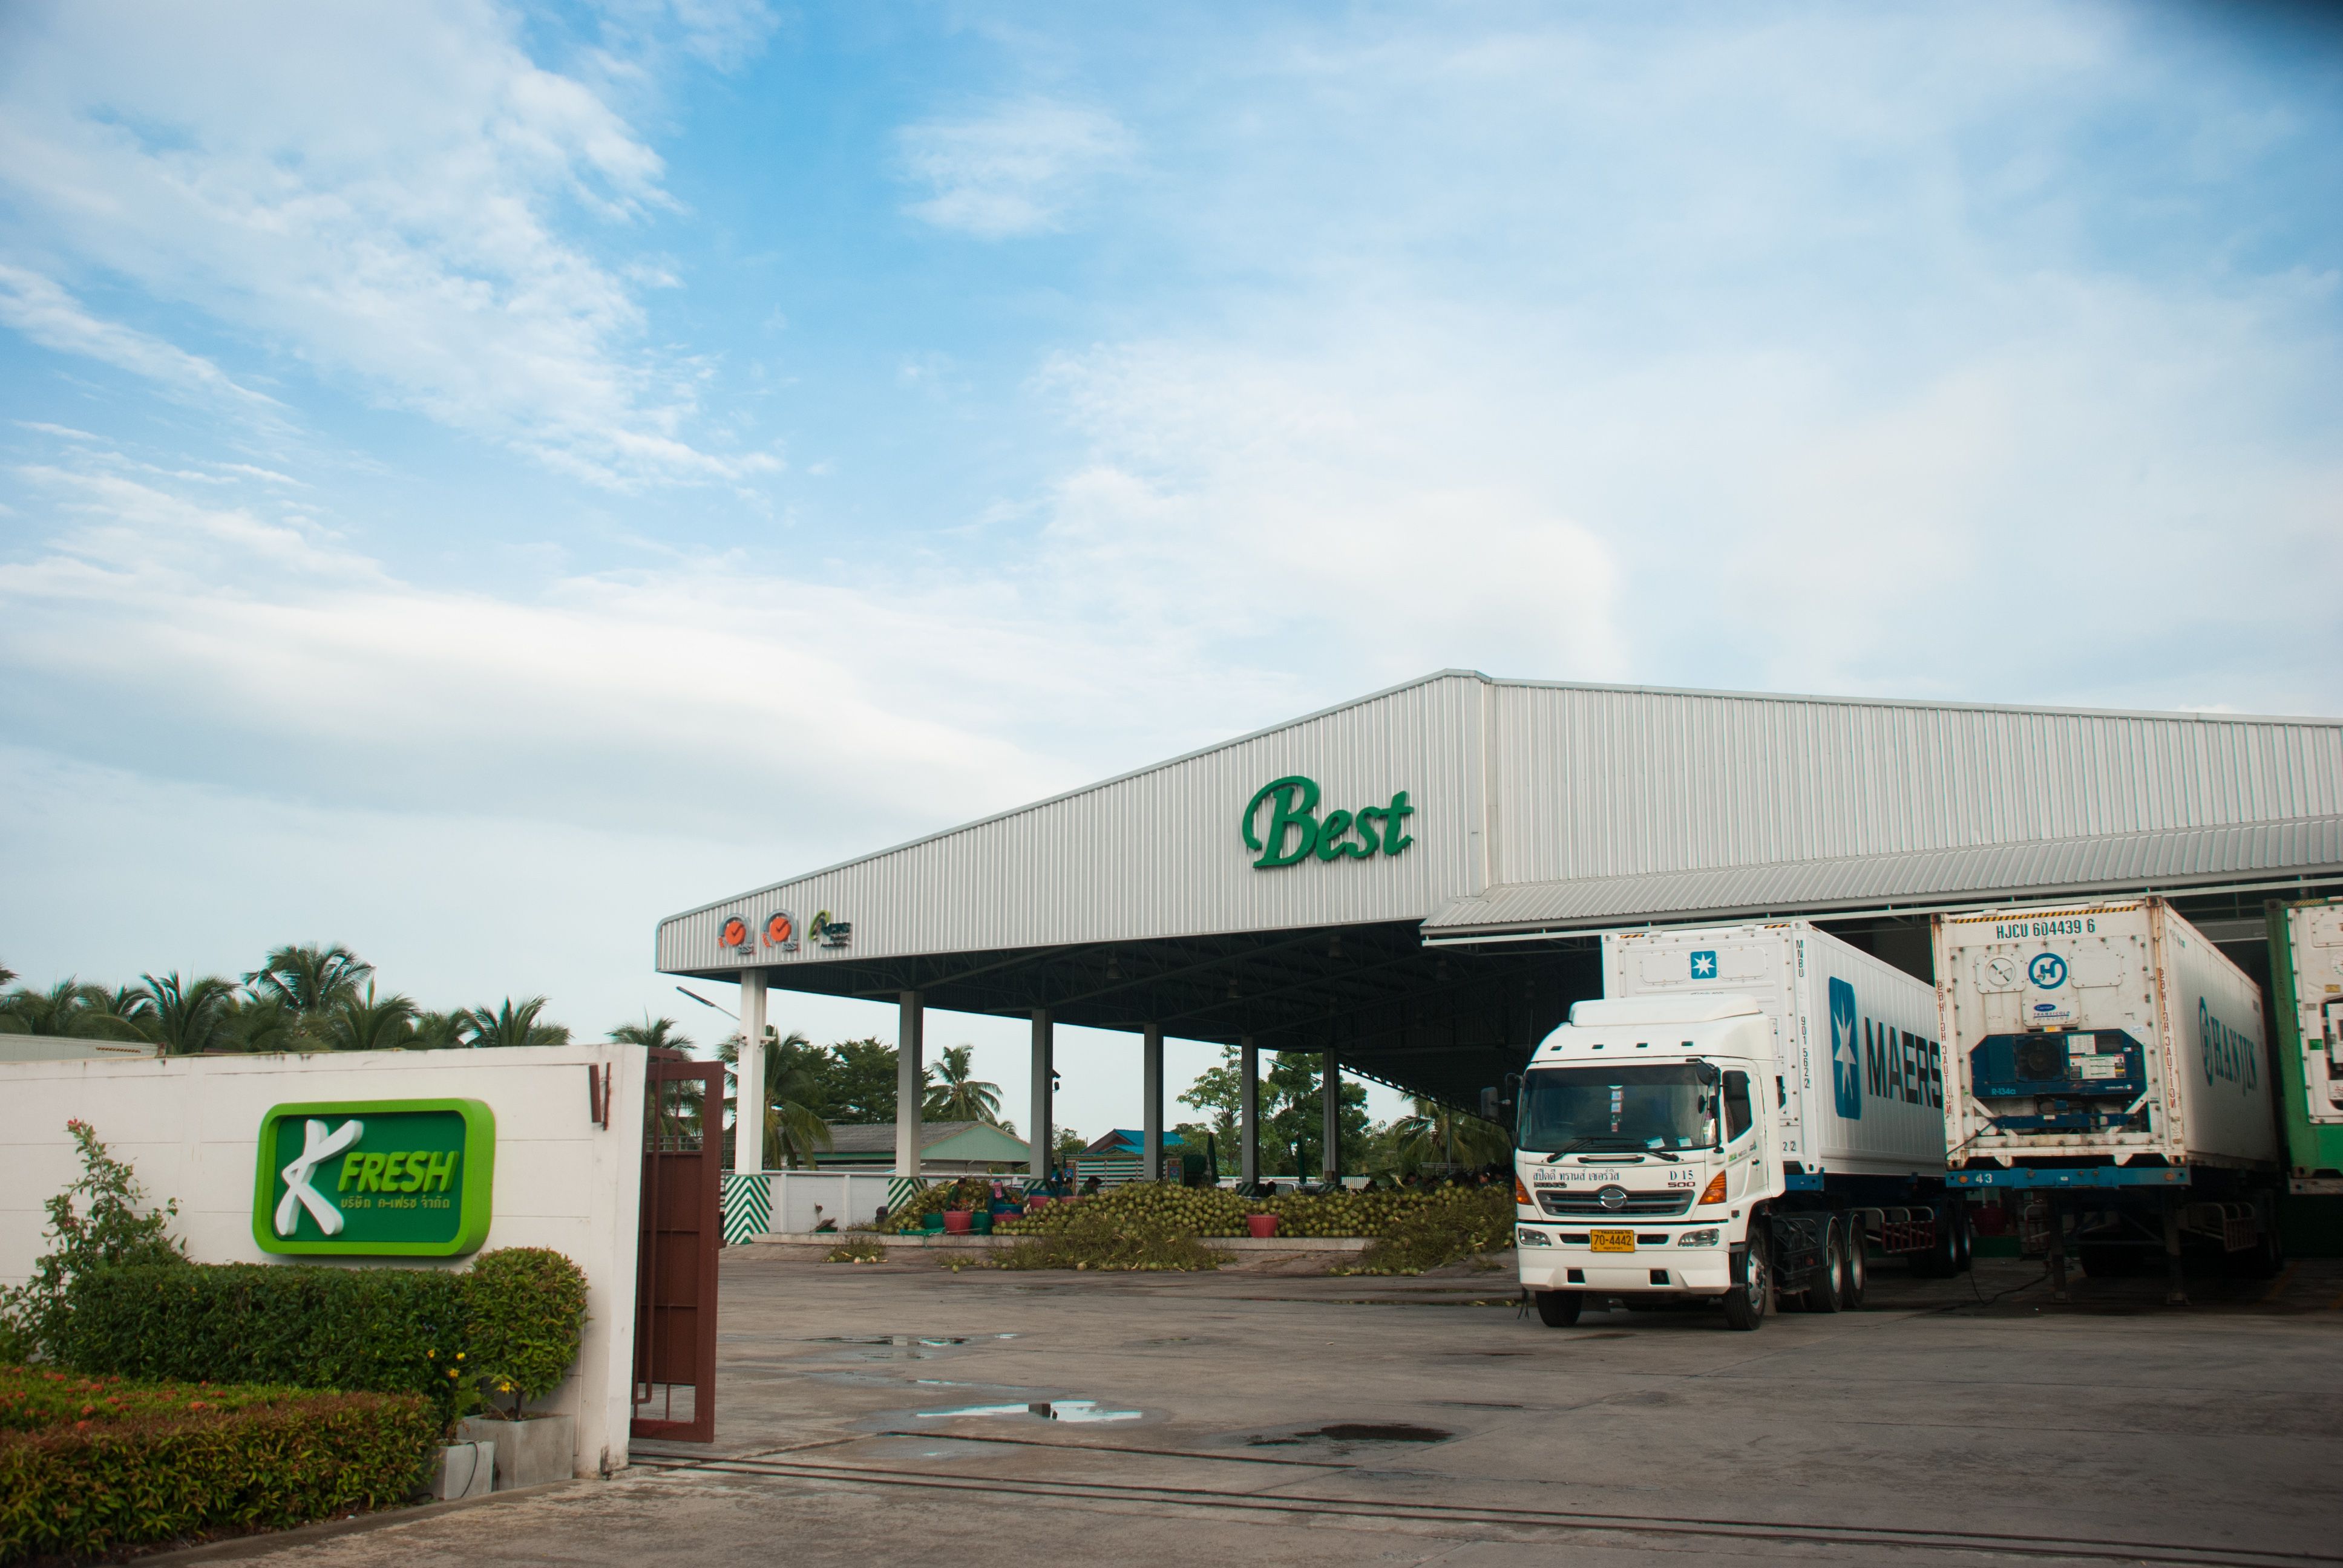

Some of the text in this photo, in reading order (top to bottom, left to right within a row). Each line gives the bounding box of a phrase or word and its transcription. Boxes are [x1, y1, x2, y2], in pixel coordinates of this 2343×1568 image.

[1242, 775, 1415, 869] Best
[1996, 918, 2096, 939] HJCU 604439 6
[337, 1151, 459, 1193] FRESH
[1670, 1170, 1694, 1180] D 15
[1976, 1173, 1993, 1184] 43
[341, 1195, 372, 1208] บริษัท
[421, 1194, 450, 1208] จำกัด
[1593, 1235, 1632, 1246] 70-4442
